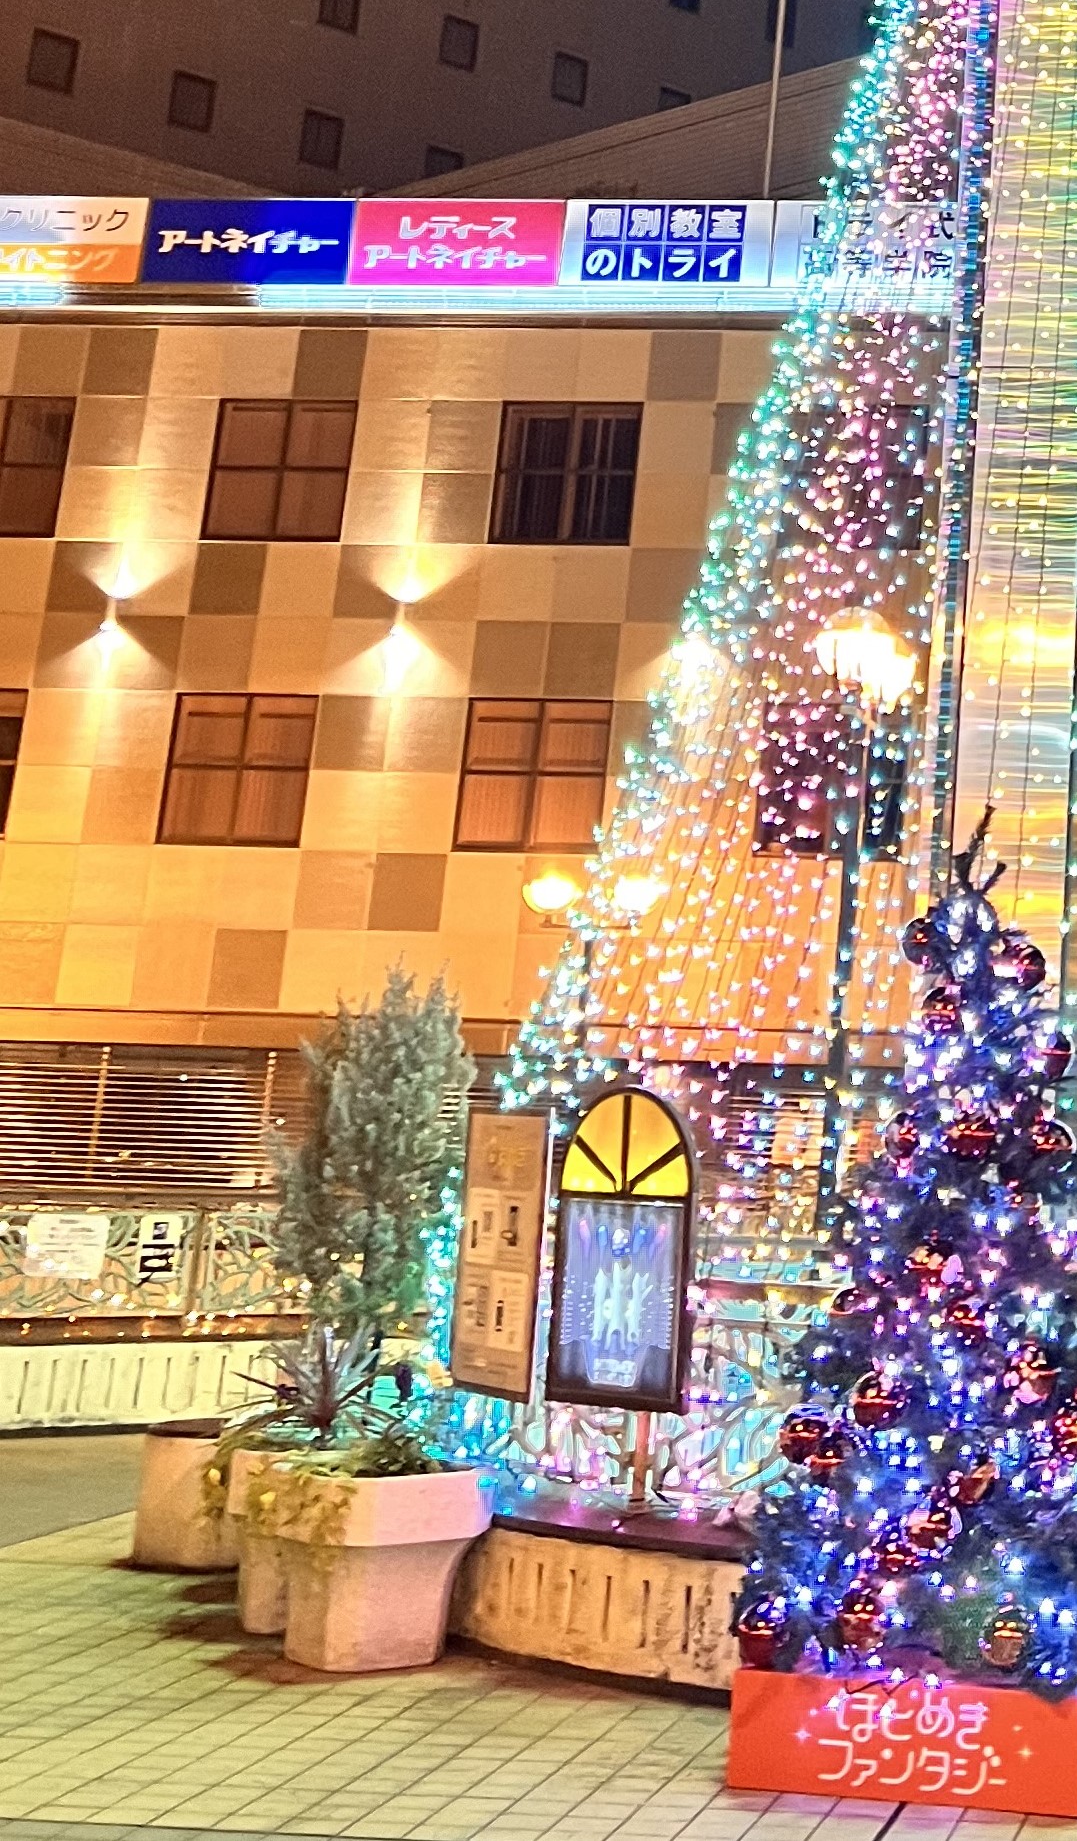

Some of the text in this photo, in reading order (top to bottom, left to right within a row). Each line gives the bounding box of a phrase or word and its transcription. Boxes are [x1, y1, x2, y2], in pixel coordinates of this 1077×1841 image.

[399, 216, 517, 240] レディース
[589, 207, 743, 240] 個別教室
[158, 228, 340, 253] アートネイチャー
[363, 243, 547, 269] アートネイチャー
[585, 248, 738, 278] のトライ
[817, 1738, 1008, 1796] ファンタジー
